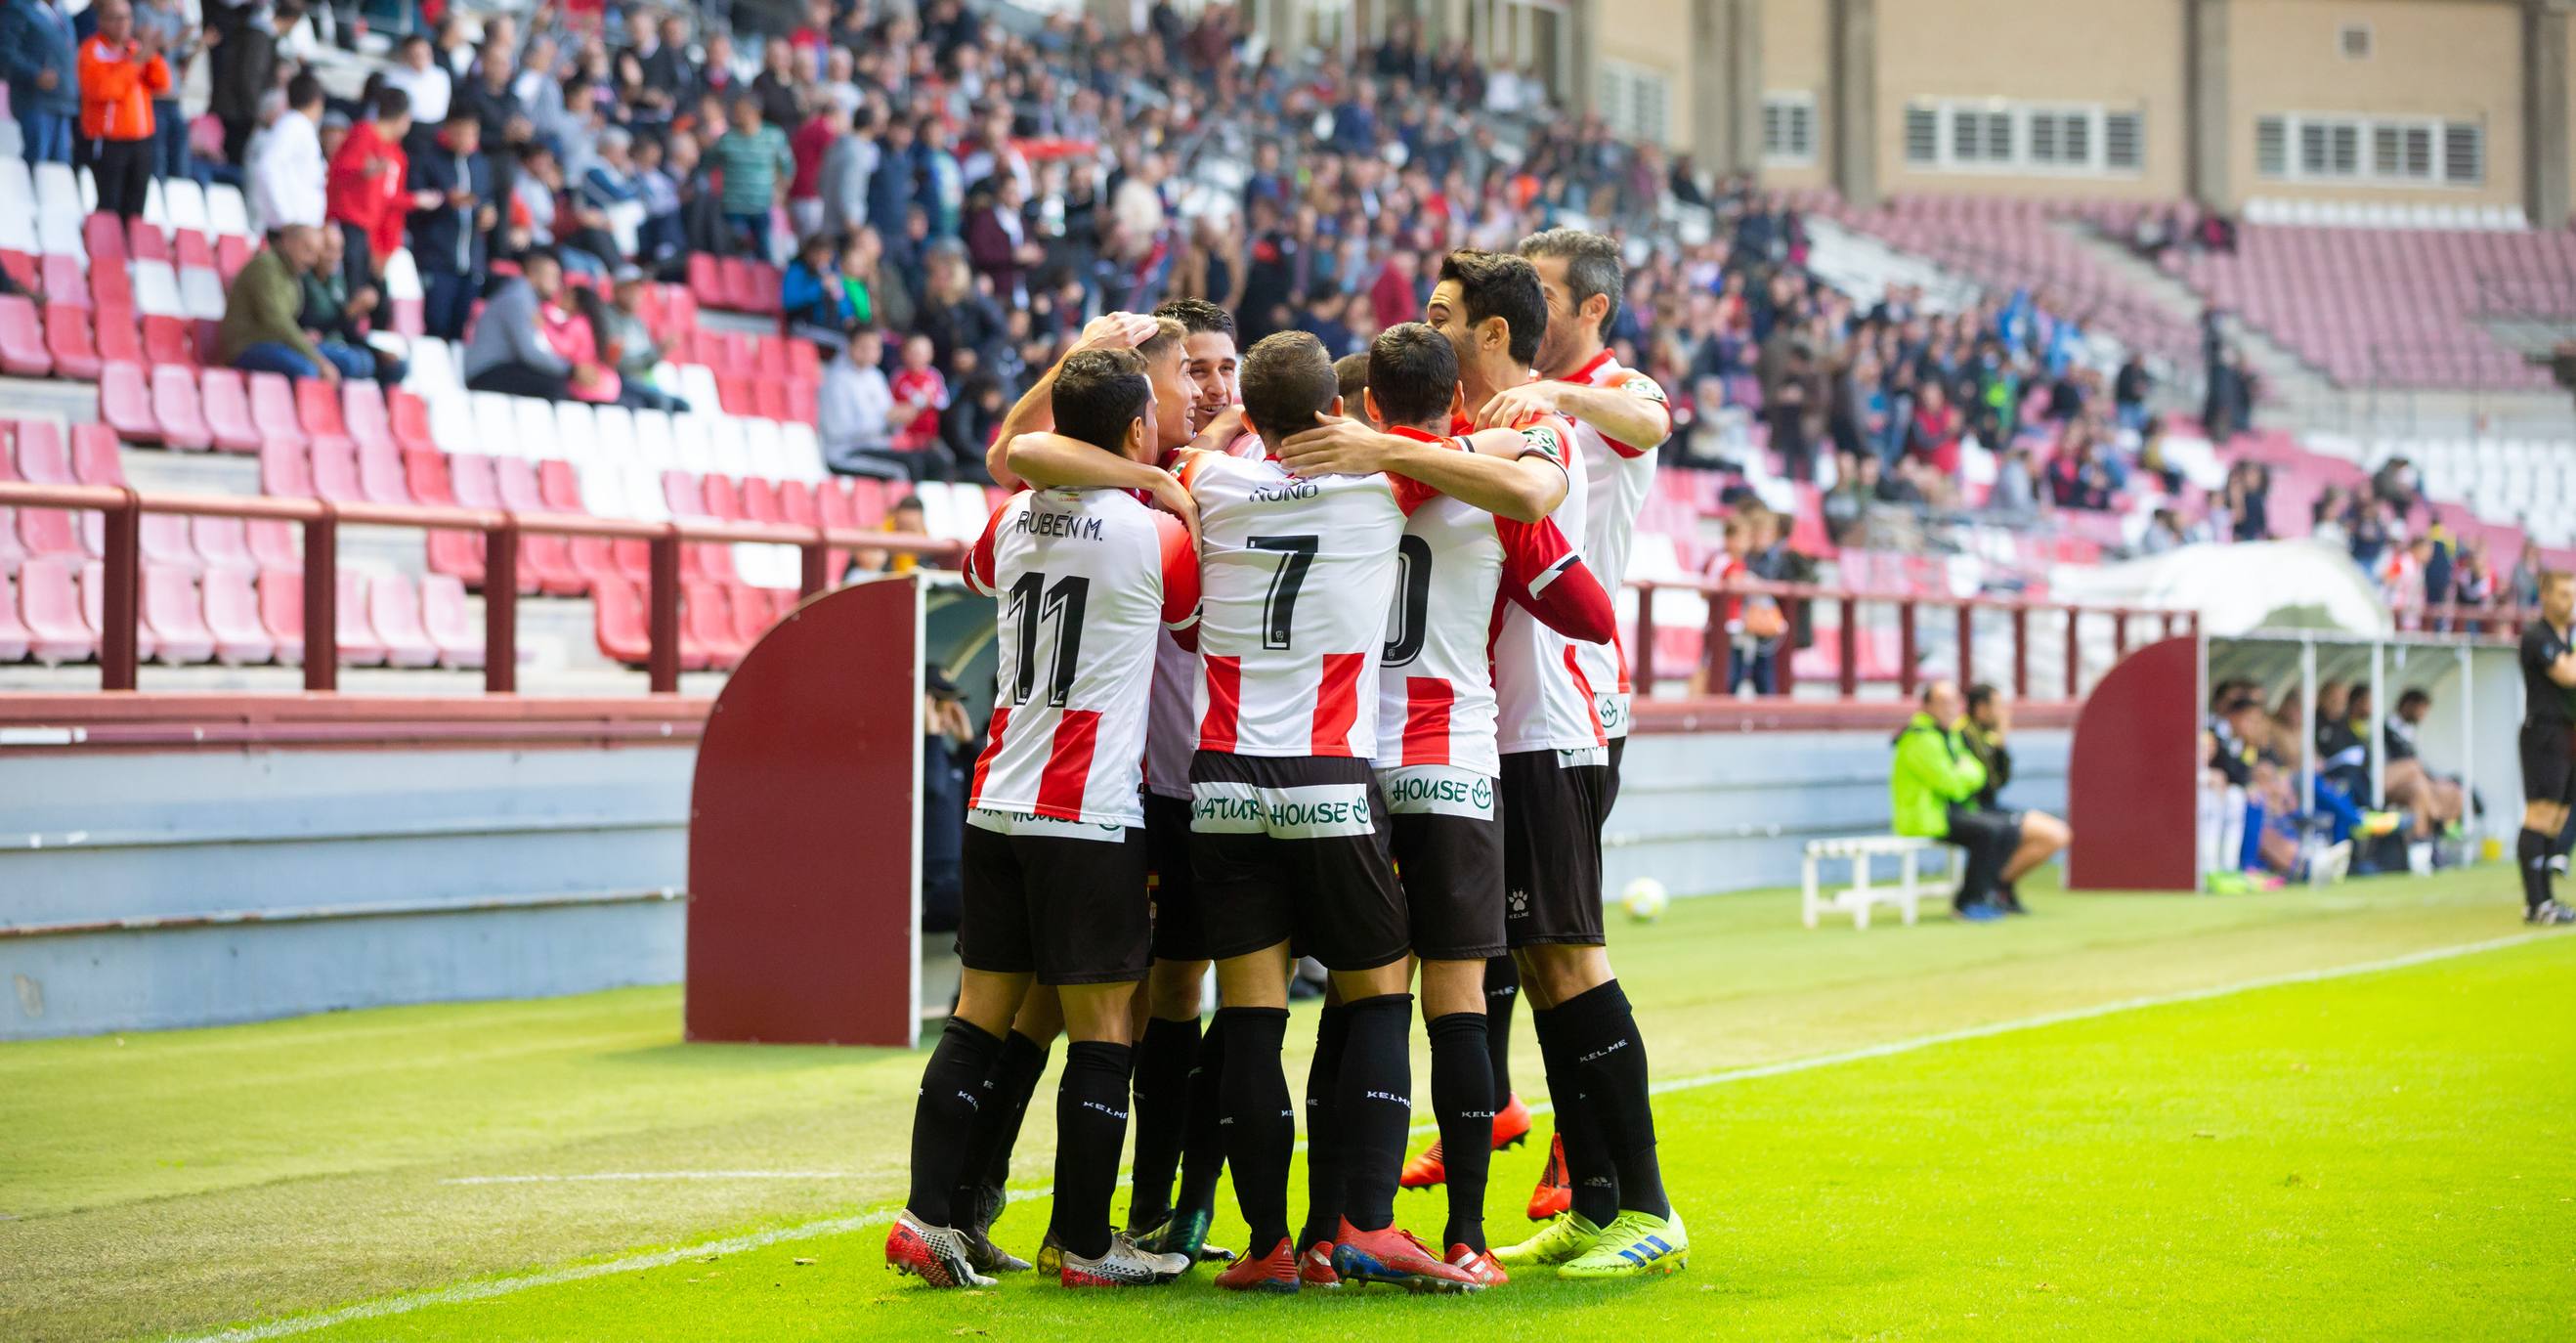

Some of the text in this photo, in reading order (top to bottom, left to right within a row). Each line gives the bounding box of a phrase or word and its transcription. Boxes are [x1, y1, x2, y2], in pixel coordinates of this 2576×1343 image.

[1016, 510, 1102, 542] RUBÉN M.
[1246, 535, 1319, 650] 7
[1007, 571, 1091, 708] 11
[1392, 778, 1469, 802] HOUSE
[1193, 796, 1349, 827] NATUR HOUSE
[1579, 1039, 1629, 1063] KELME
